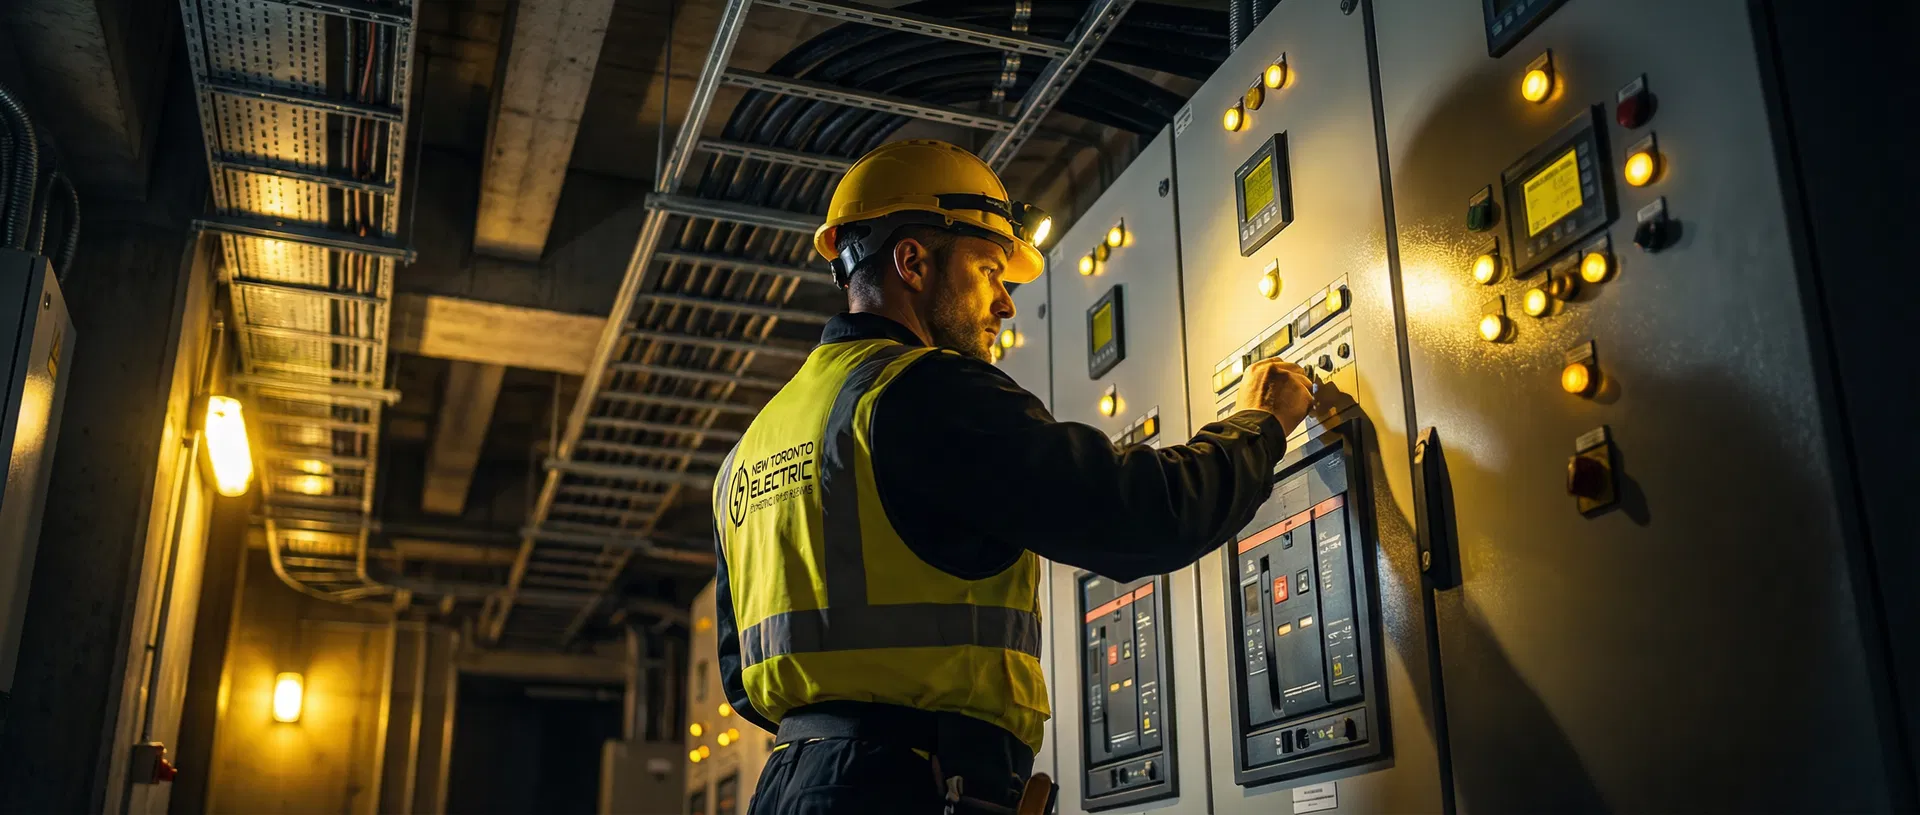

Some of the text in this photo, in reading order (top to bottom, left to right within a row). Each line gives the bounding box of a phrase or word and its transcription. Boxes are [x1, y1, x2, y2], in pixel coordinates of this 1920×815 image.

[751, 441, 814, 476] NEW TORONTO
[750, 459, 813, 499] ELECTRIC
